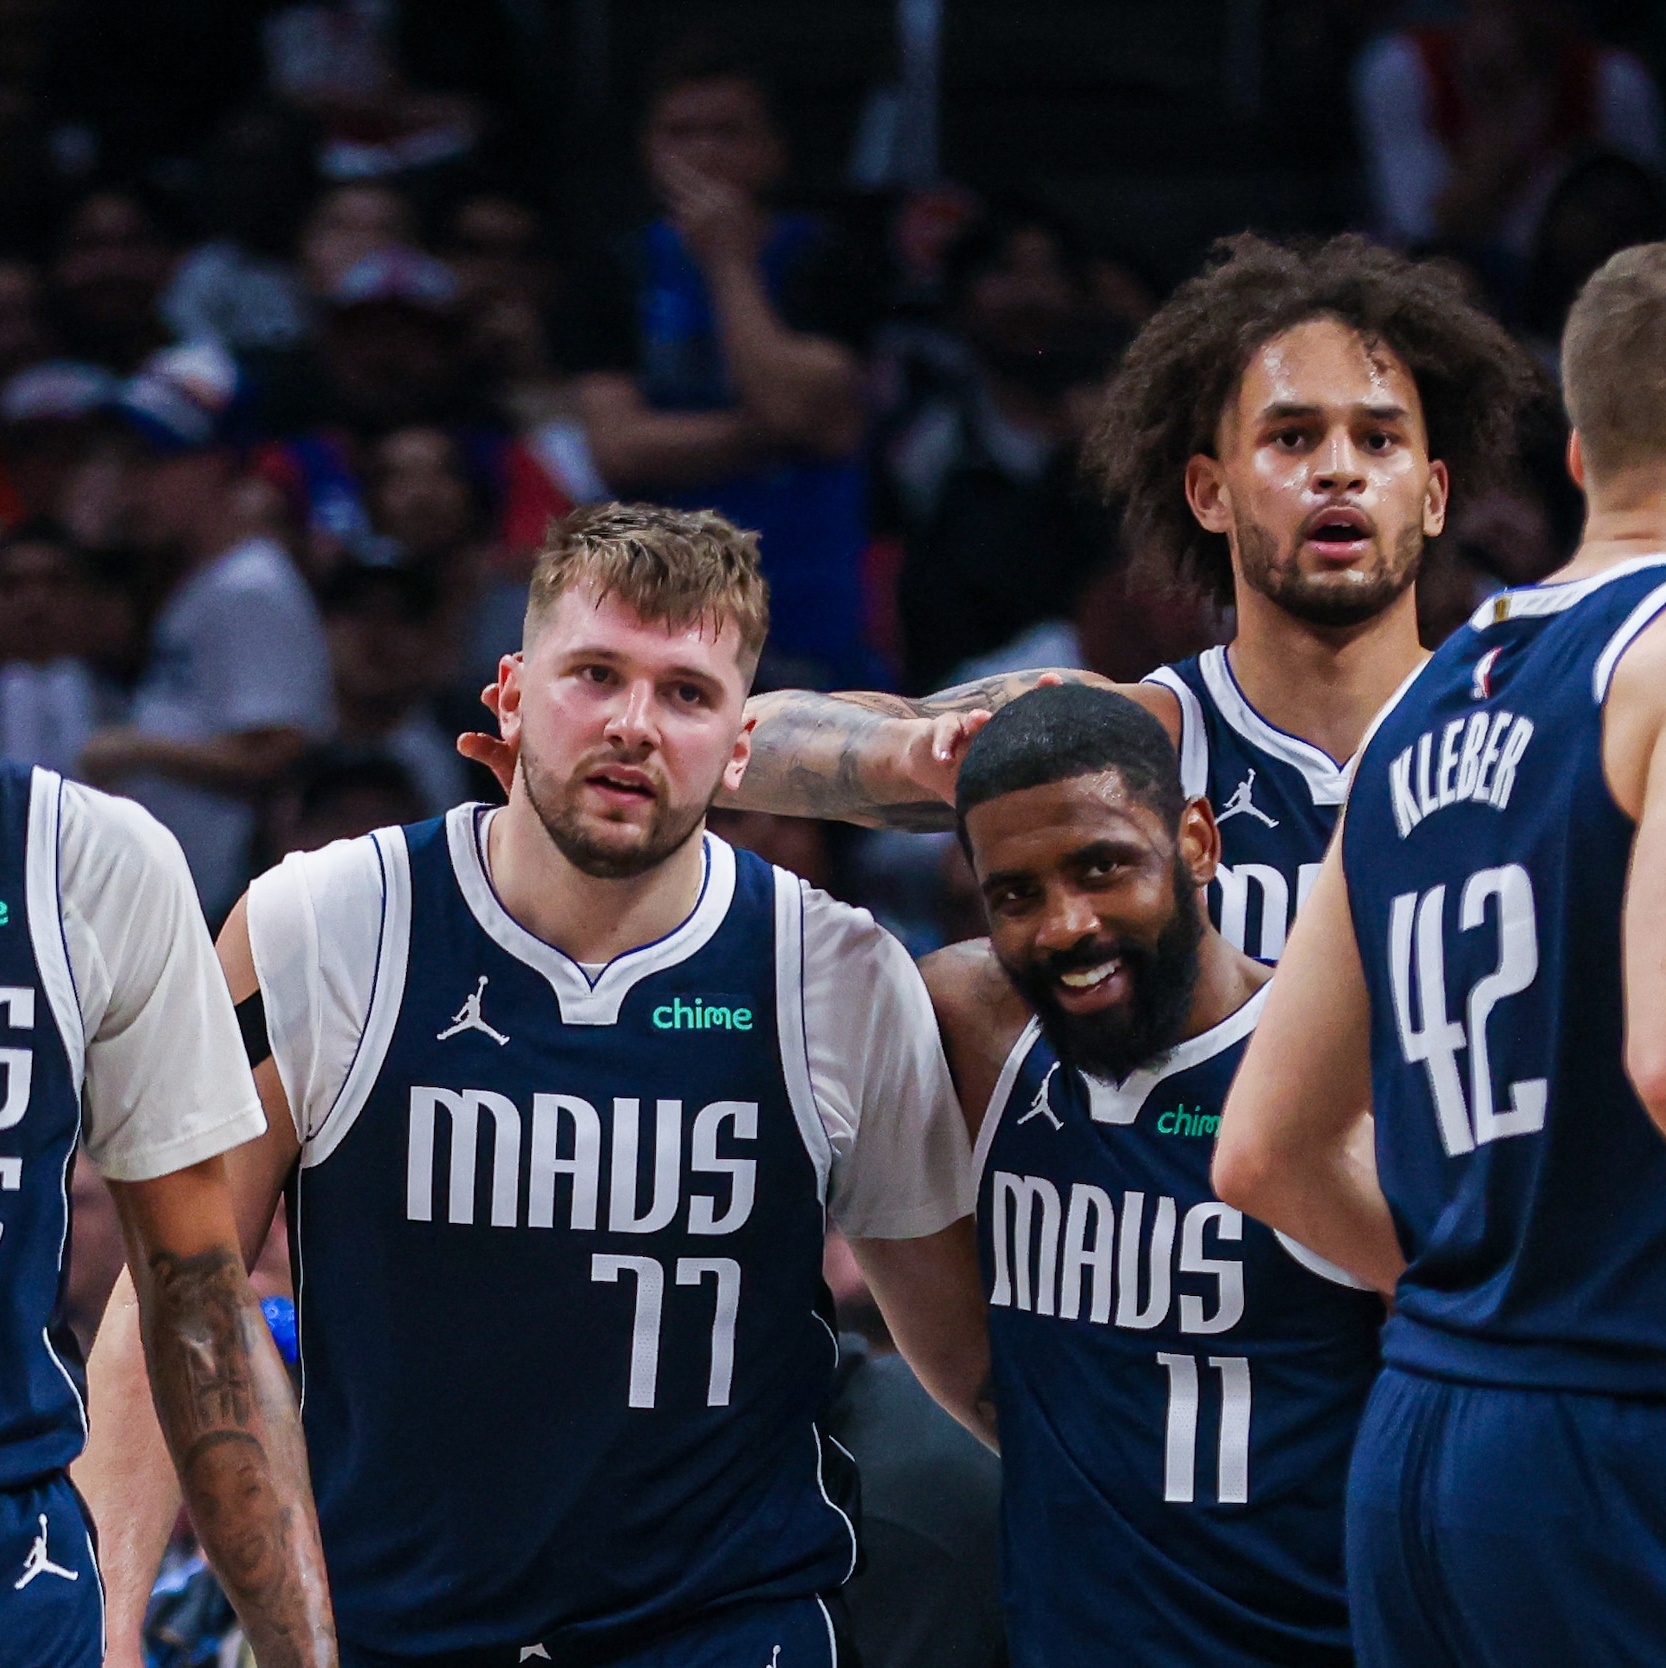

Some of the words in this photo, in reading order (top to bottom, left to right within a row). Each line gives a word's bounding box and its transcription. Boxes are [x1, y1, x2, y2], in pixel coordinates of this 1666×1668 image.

[1389, 711, 1535, 839] KLEBER
[652, 997, 753, 1031] chime
[1389, 863, 1548, 1157] 42
[406, 1085, 759, 1235] MAVS
[1157, 1103, 1222, 1138] chim
[989, 1170, 1246, 1335] MAVS
[590, 1253, 741, 1409] 77
[1156, 1351, 1252, 1504] 11
